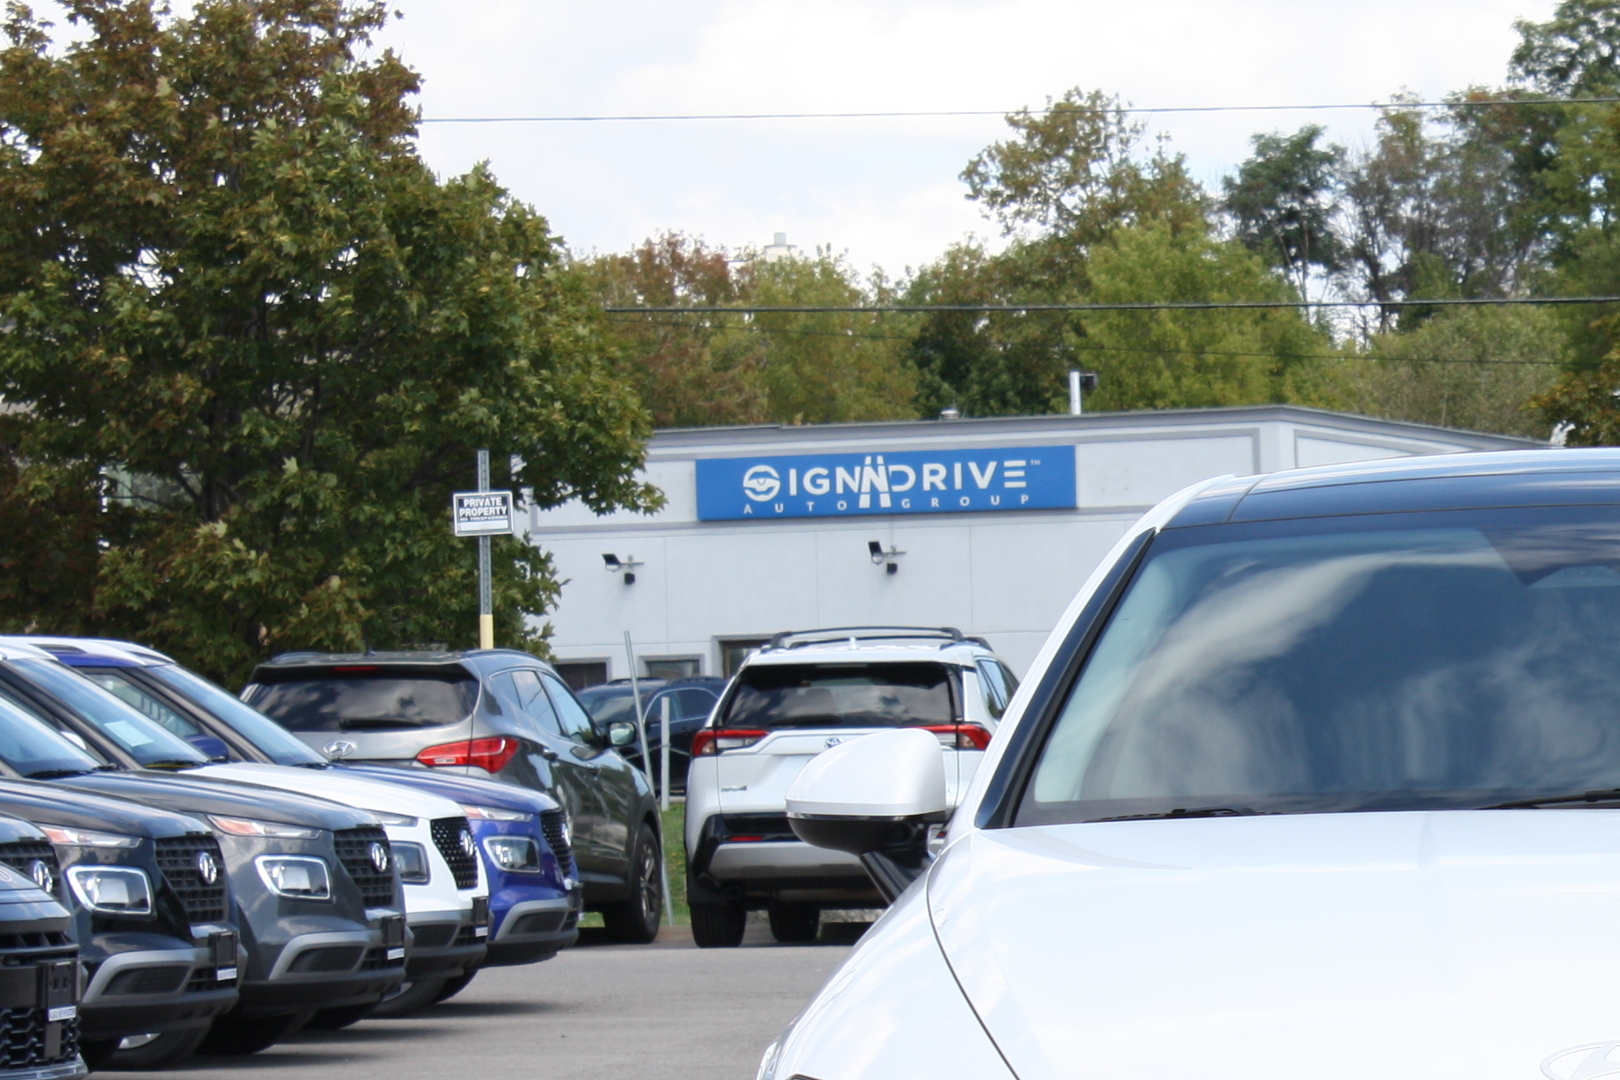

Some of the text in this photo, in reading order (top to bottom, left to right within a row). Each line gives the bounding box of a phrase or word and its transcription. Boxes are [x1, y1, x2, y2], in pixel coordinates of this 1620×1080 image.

[463, 496, 503, 507] PRIVATE
[743, 494, 1029, 514] AUTO GROUP
[459, 505, 507, 517] PROPERTY
